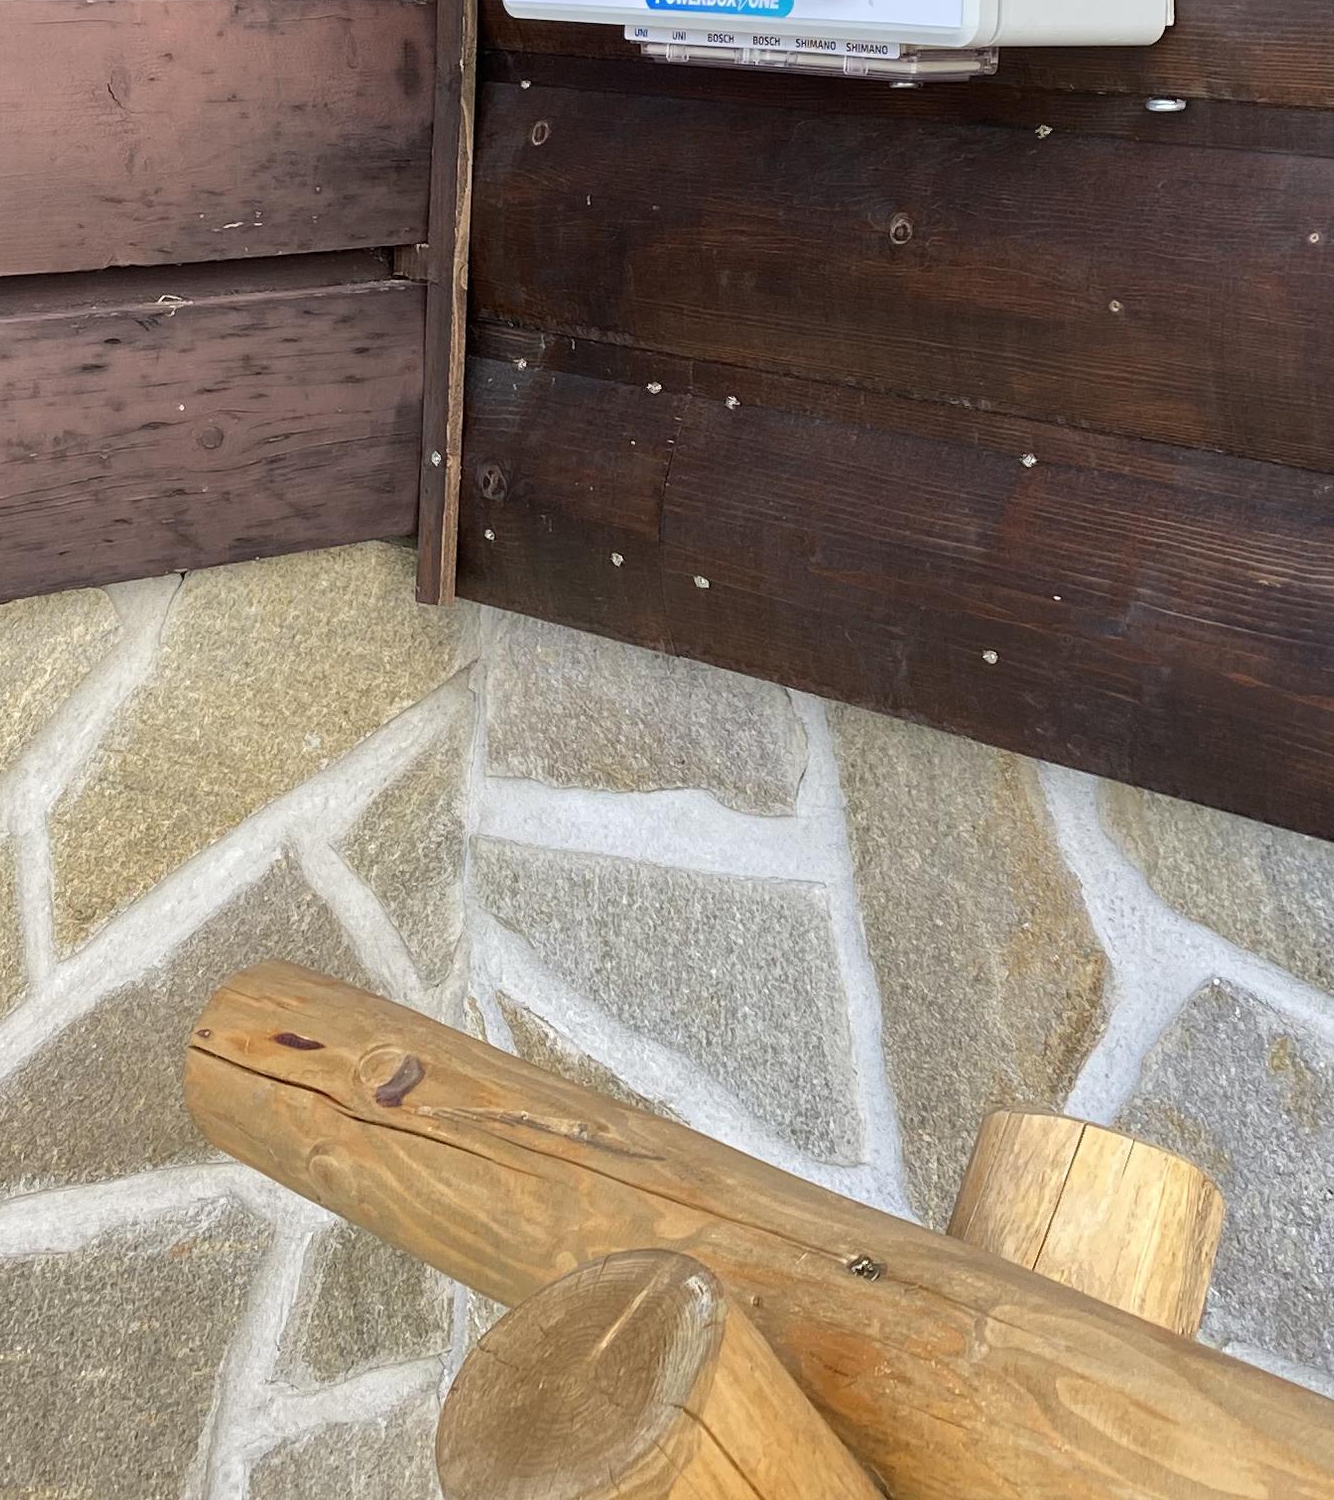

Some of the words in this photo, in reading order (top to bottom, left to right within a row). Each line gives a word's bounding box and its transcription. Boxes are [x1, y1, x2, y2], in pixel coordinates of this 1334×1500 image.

[635, 29, 648, 37] UNI
[673, 31, 686, 40] UNI
[708, 34, 734, 44] BOSCH
[753, 36, 780, 46] BOSCH
[796, 39, 836, 50] SHIMANO
[846, 43, 888, 55] SHIMANO
